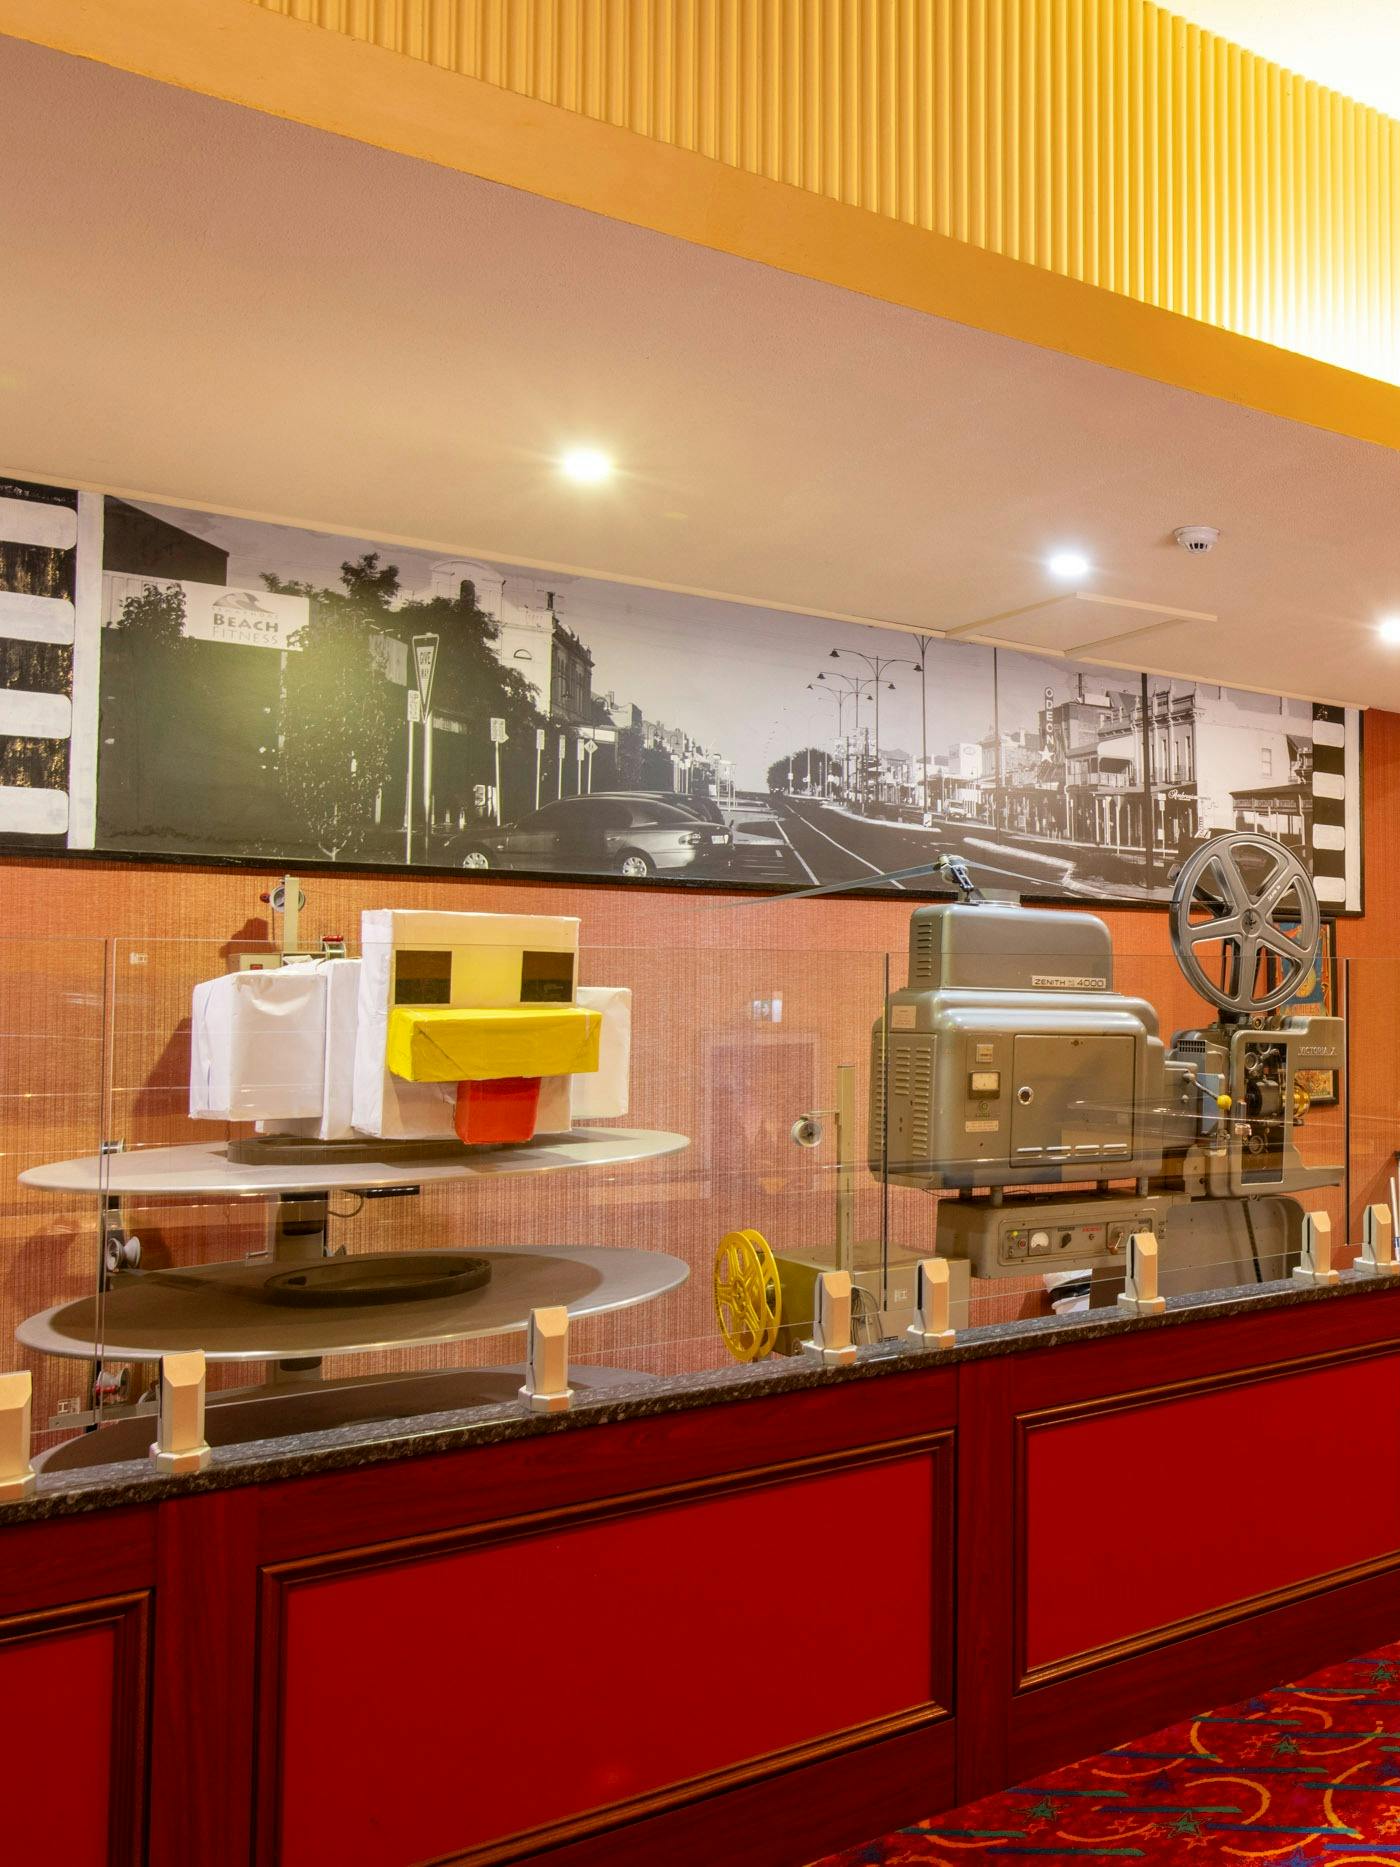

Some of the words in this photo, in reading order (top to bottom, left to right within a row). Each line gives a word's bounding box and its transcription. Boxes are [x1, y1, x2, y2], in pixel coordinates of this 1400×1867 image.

[213, 613, 279, 632] BEACH
[212, 625, 279, 645] FITNESS
[1045, 687, 1054, 745] ODEON
[1077, 979, 1104, 987] 4000
[1298, 1046, 1328, 1056] VICTORIA
